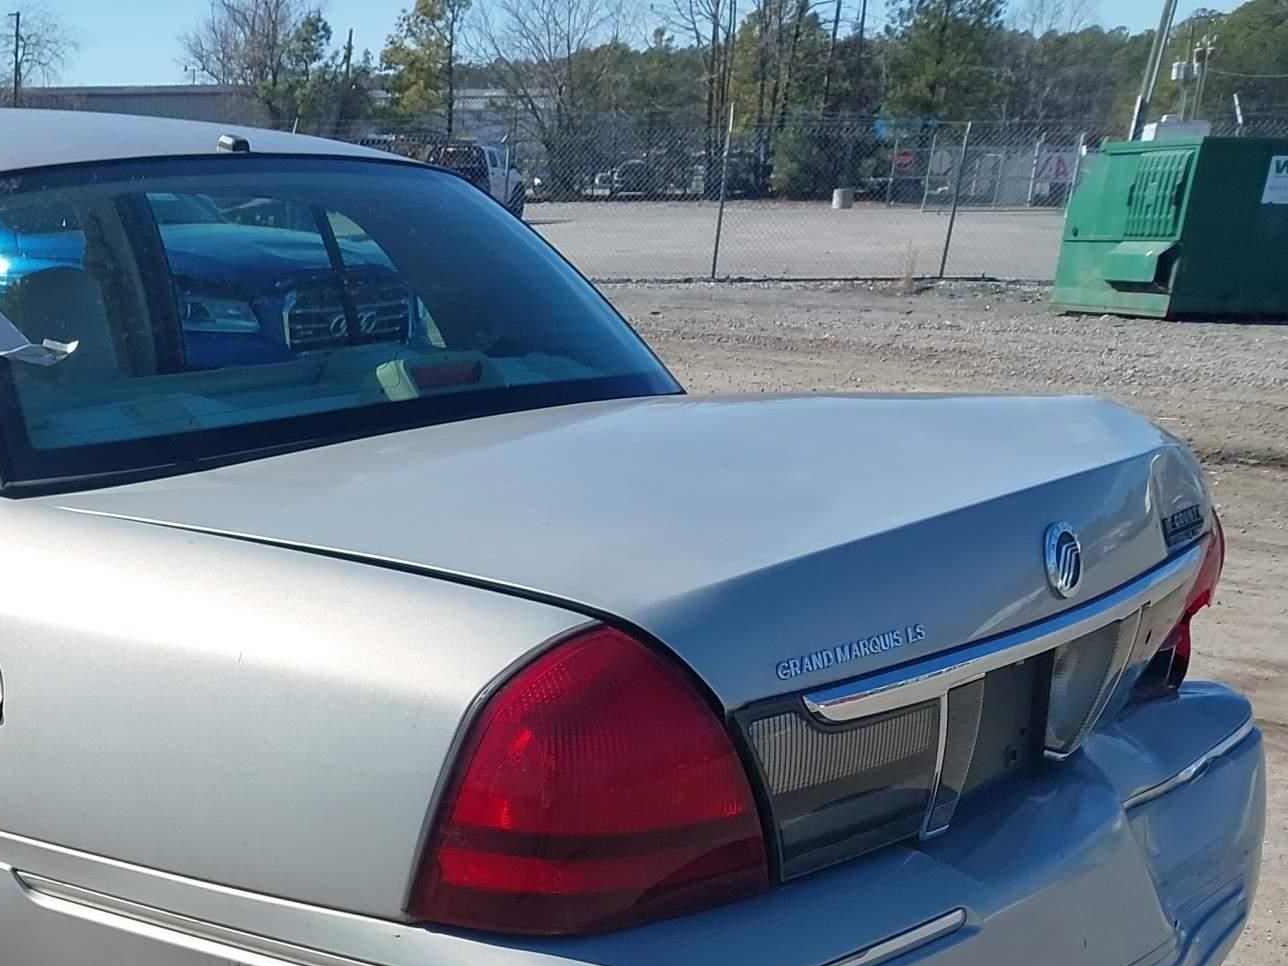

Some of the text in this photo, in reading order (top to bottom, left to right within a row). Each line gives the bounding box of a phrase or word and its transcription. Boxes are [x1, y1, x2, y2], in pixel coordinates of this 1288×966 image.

[776, 624, 926, 679] GRAND MARQUIS LS
